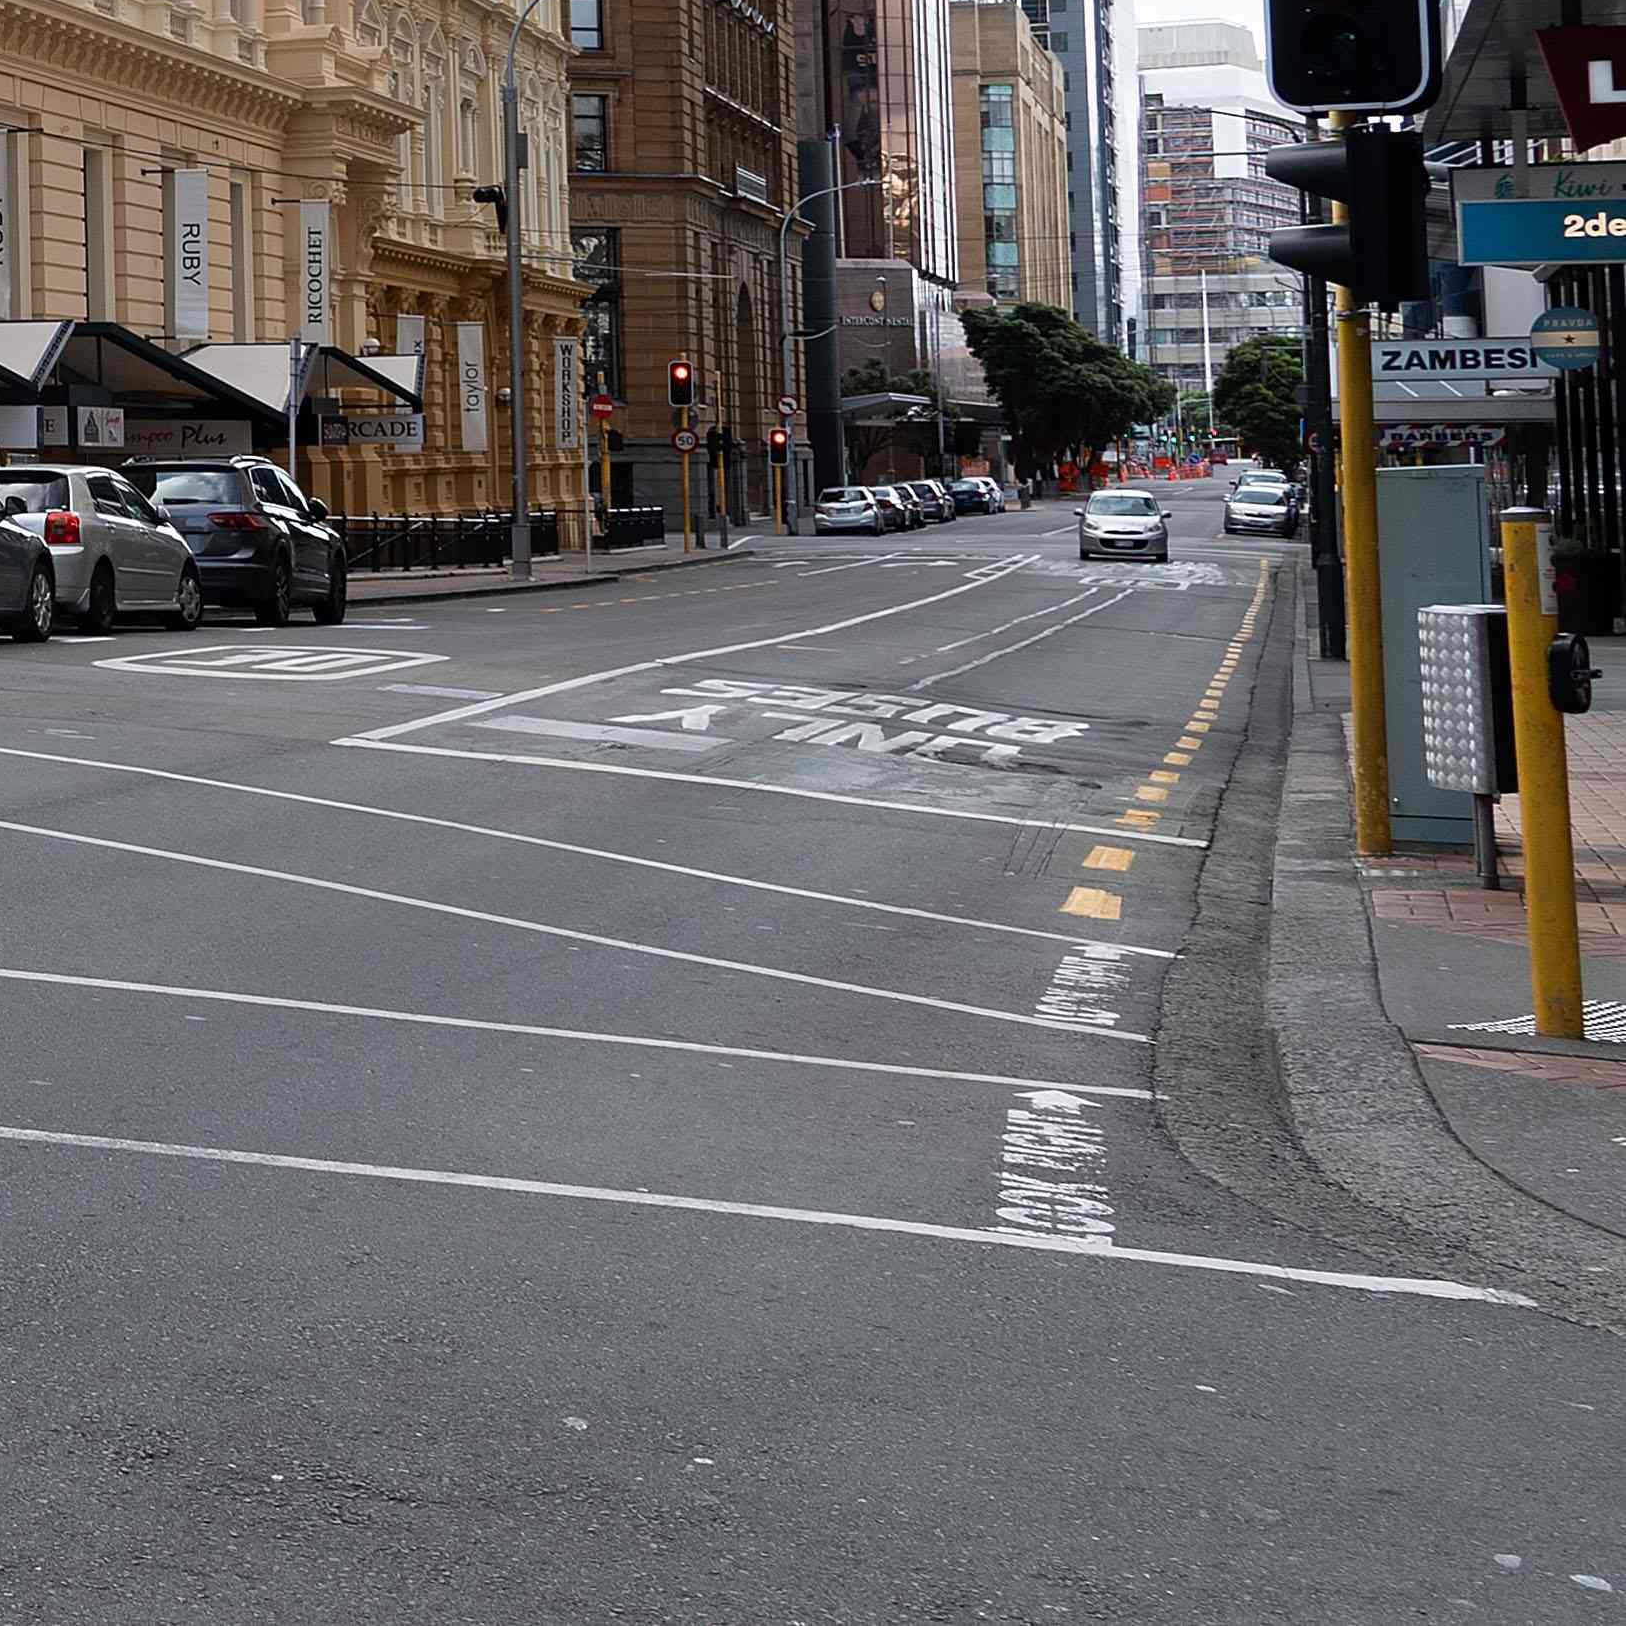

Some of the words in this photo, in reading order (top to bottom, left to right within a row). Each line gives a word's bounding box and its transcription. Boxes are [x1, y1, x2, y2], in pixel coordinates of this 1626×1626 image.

[182, 223, 201, 285] RUBY
[308, 227, 323, 324] RICOCHET
[463, 362, 484, 412] taylor
[560, 344, 573, 442] WORKSHOP
[181, 425, 227, 449] Plus
[678, 435, 694, 446] 50
[660, 678, 1090, 743] BUSES
